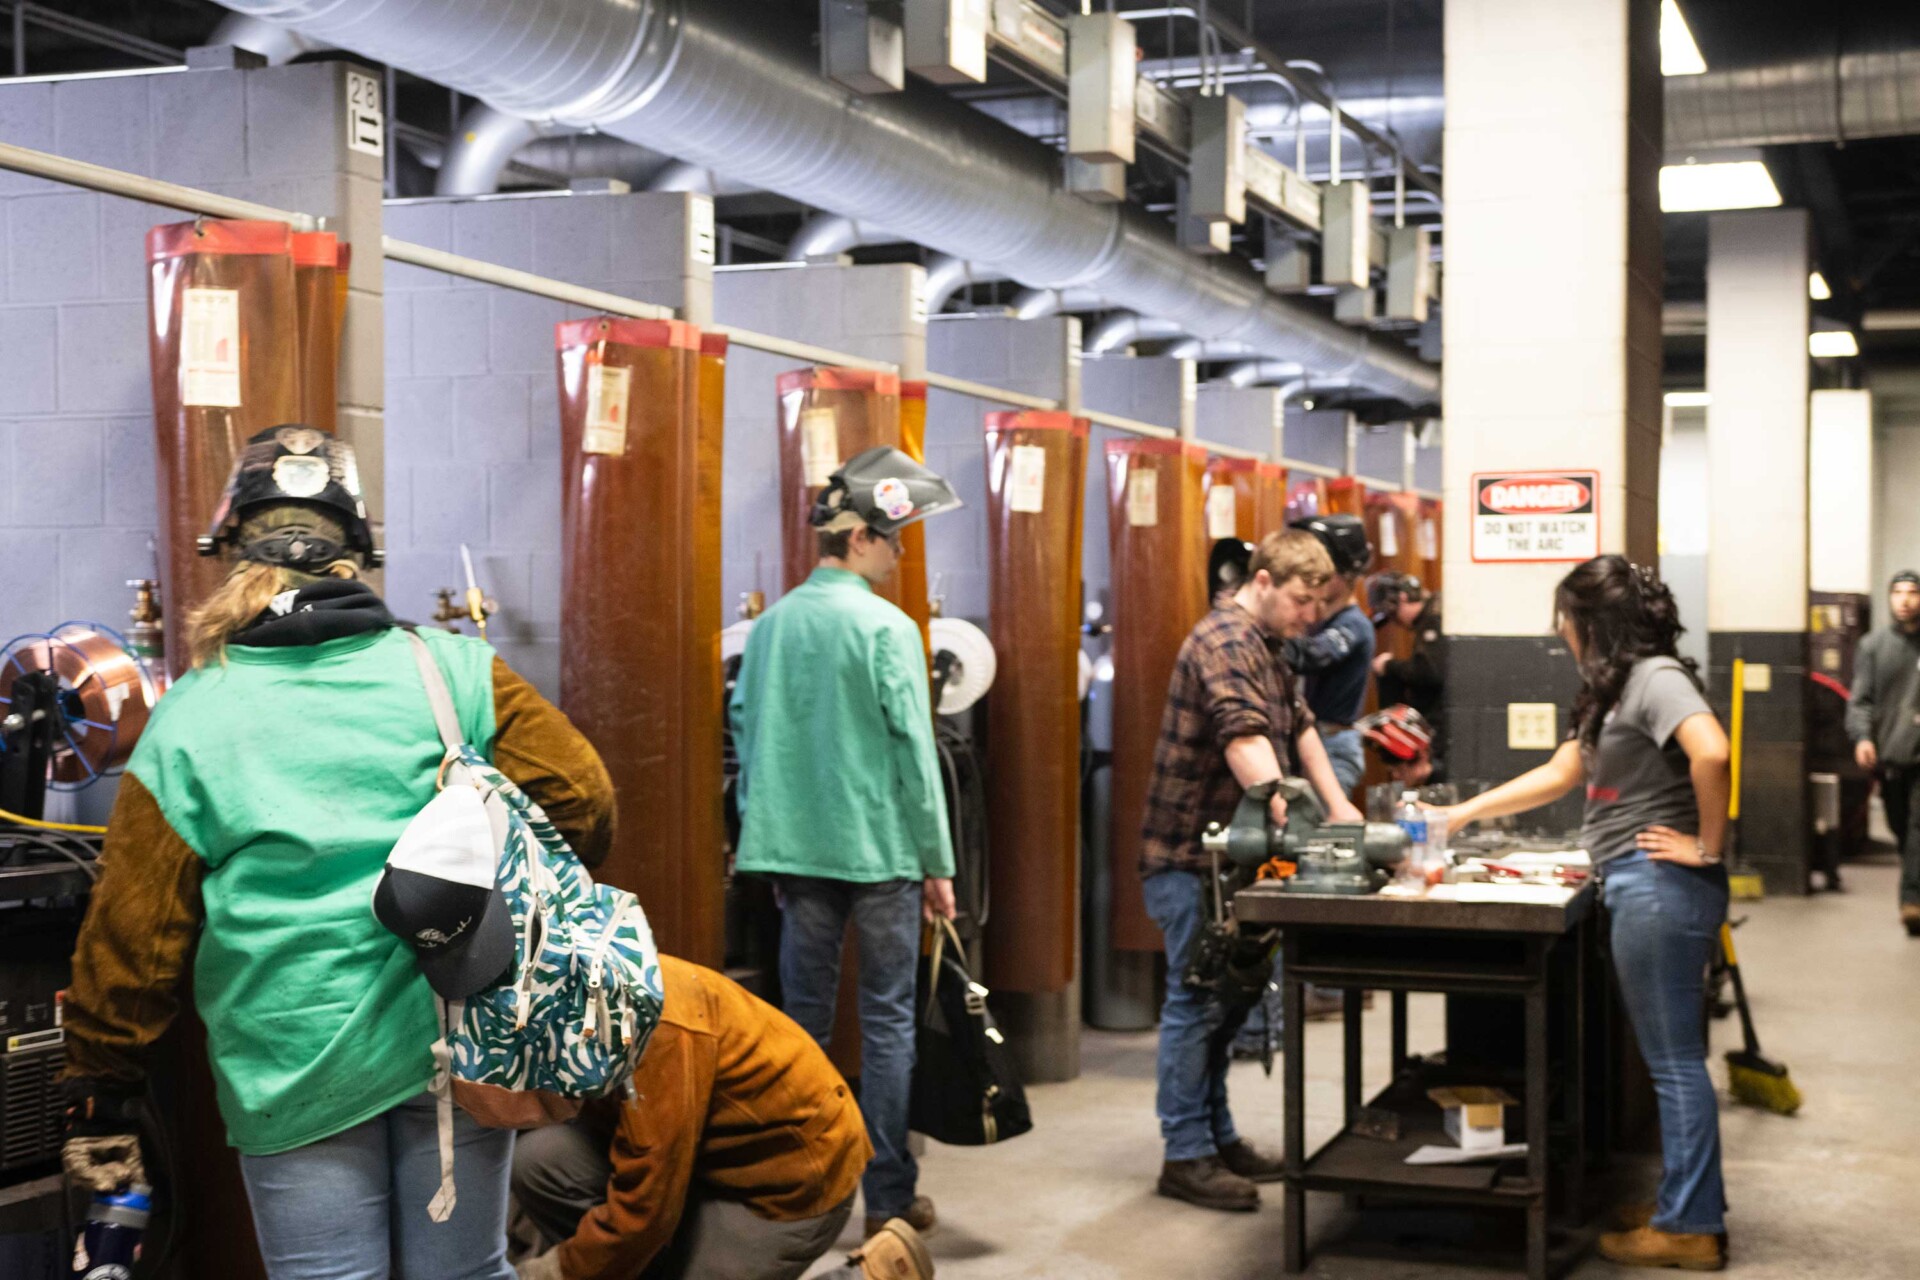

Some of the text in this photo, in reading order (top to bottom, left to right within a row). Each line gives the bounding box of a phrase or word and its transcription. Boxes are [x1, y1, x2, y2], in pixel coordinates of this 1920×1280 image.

[351, 76, 375, 109] 28
[1490, 484, 1580, 508] DANGER
[1484, 520, 1586, 534] DO NOT WATCH
[1508, 538, 1563, 551] THE ARC
